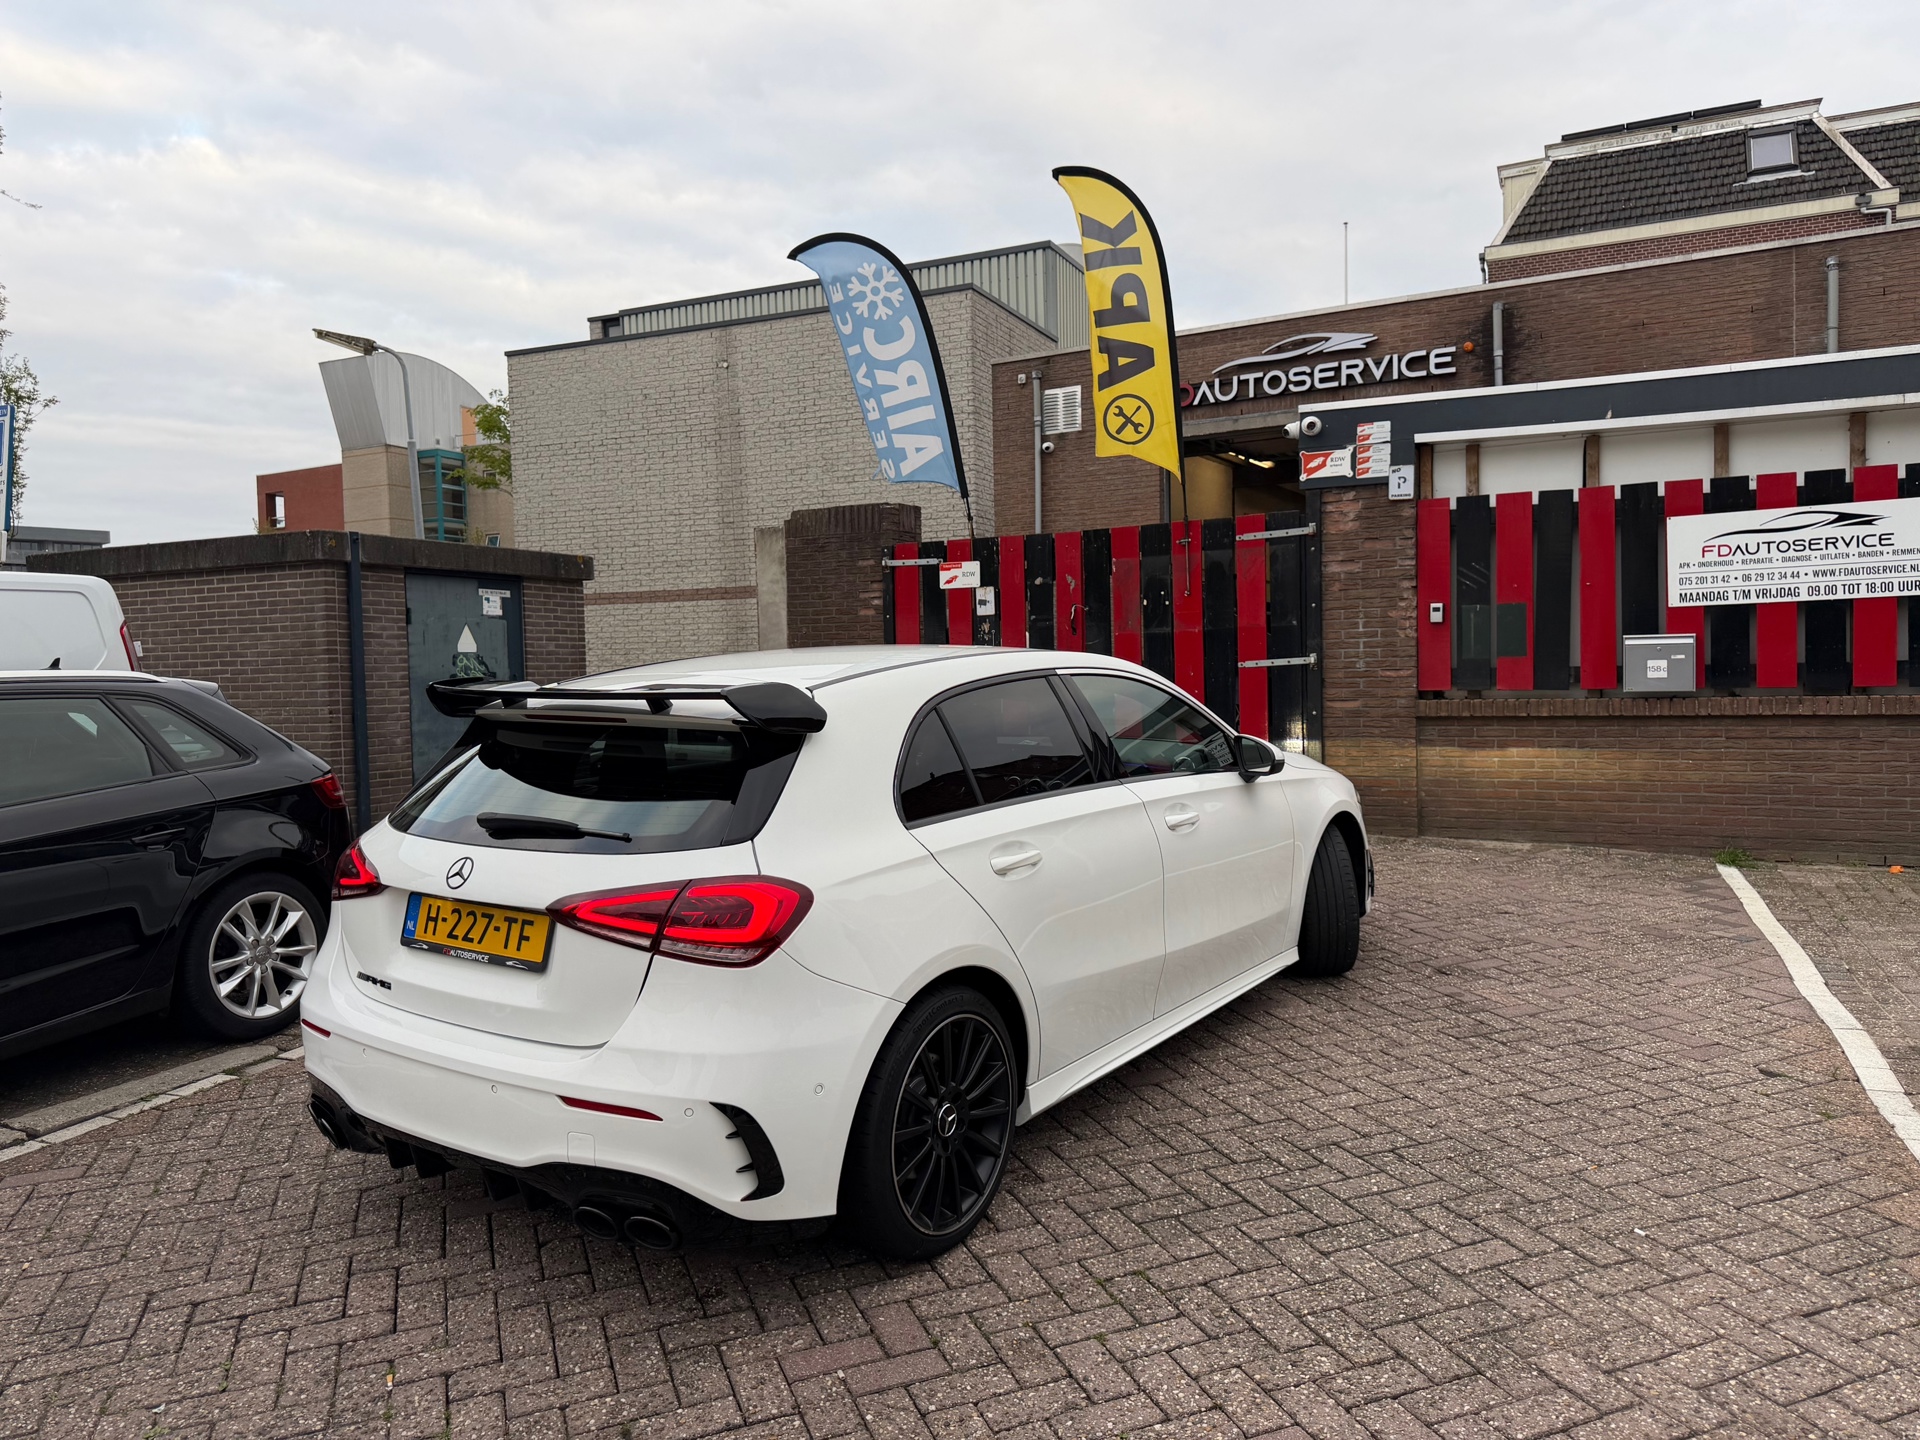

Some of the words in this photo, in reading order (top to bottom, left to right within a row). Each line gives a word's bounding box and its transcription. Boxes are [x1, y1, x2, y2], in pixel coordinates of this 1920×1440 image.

[1180, 346, 1457, 408] DAUTOSERVICE
[1701, 532, 1895, 558] FDAUTOSERVICE
[1697, 559, 1734, 568] ONDERHOUD
[1741, 556, 1774, 566] REPARATIE
[1781, 554, 1813, 563] DIAGNOSE
[1819, 552, 1850, 561] UITLATEN
[1857, 549, 1884, 558] BANDEN
[1892, 547, 1920, 556] REMMEN
[1679, 577, 1693, 586] 075
[1695, 575, 1708, 585] 201
[1710, 575, 1719, 584] 31
[1721, 574, 1731, 583] 42
[1742, 573, 1752, 582] 06
[1754, 572, 1765, 581] 29
[1767, 571, 1775, 581] 12
[1778, 571, 1788, 580] 34
[1790, 570, 1800, 579] 44
[1812, 563, 1920, 578] WWW.FDAUTOSERVICE.NL
[1679, 590, 1729, 603] MAANDAG
[1732, 588, 1751, 601] T/M
[1755, 586, 1800, 599] VRIJDAG
[1807, 584, 1838, 597] 09.00
[1841, 582, 1862, 595] TOT
[1865, 580, 1894, 594] 18:00
[1898, 580, 1920, 592] UUR
[407, 920, 415, 931] NL
[424, 903, 535, 952] H-227-TF
[443, 948, 489, 963] FDAUTOSERVICE
[363, 973, 392, 991] AMG
